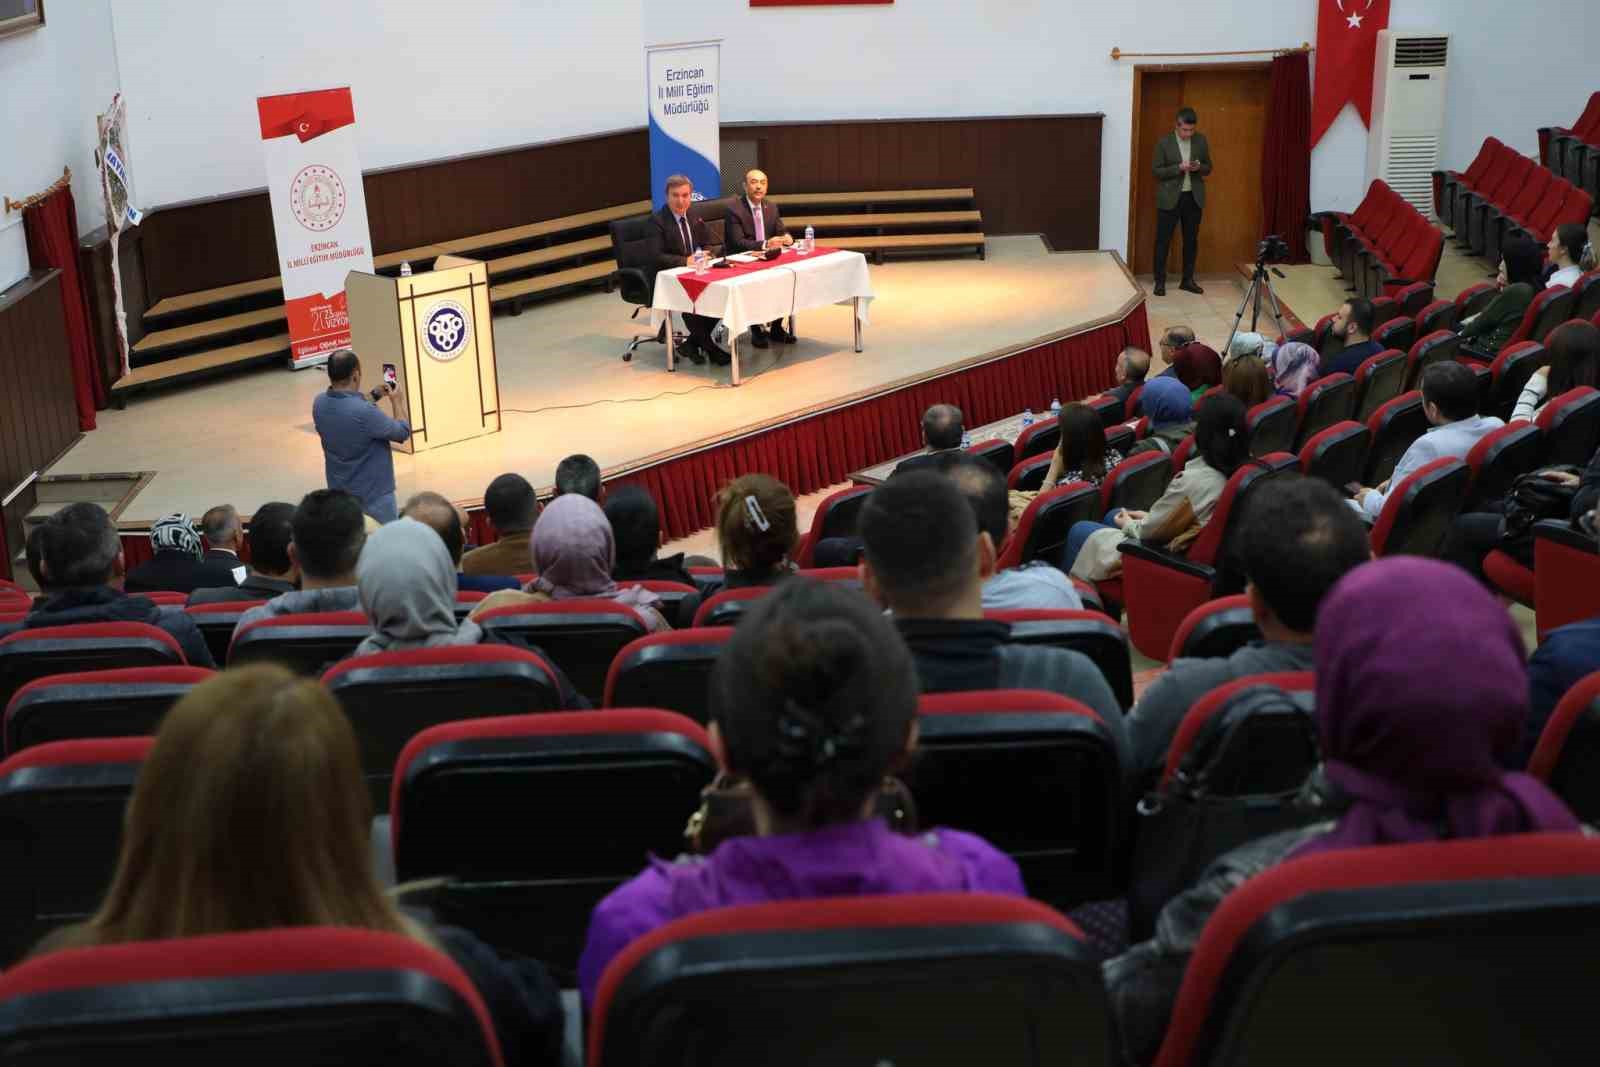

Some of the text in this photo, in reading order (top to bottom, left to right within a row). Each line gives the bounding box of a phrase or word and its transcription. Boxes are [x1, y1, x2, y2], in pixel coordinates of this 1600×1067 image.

[666, 68, 704, 81] Erzincan
[658, 84, 664, 99] İl
[686, 82, 713, 98] Eğitim
[663, 99, 709, 116] Müdürlüğü
